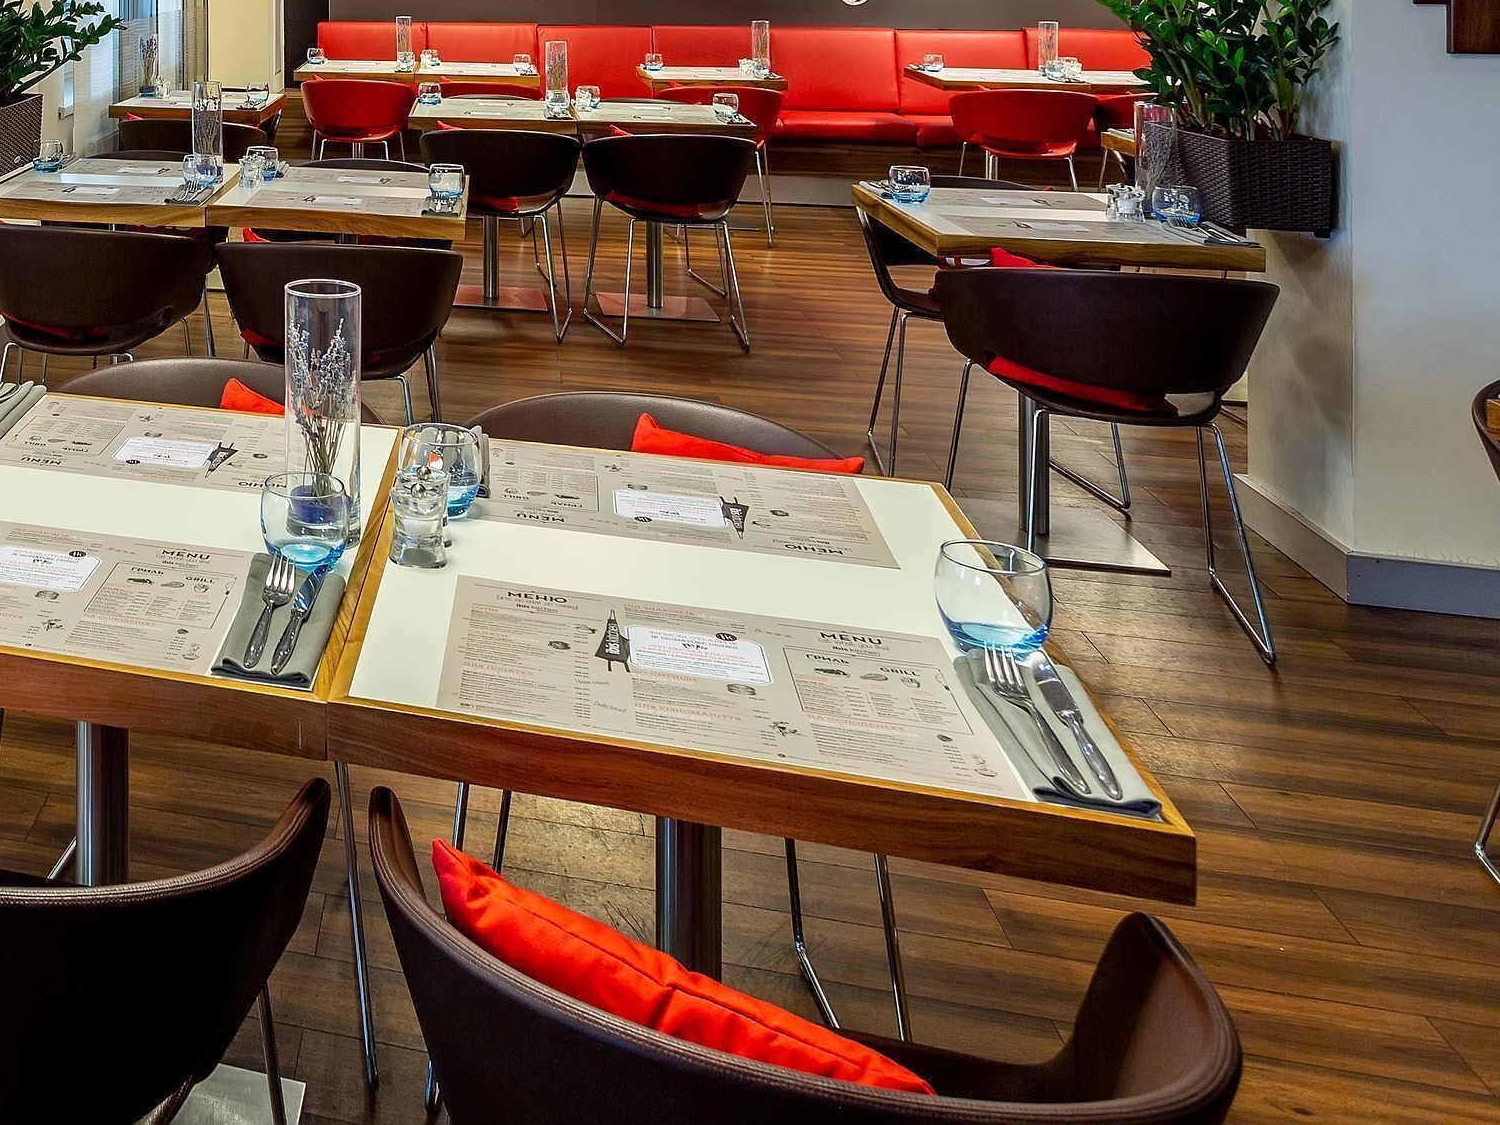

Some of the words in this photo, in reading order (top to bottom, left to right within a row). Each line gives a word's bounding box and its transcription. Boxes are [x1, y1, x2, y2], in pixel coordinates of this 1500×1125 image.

[161, 549, 211, 561] MENU
[507, 591, 569, 605] МЕНЮ
[820, 631, 883, 646] MENU
